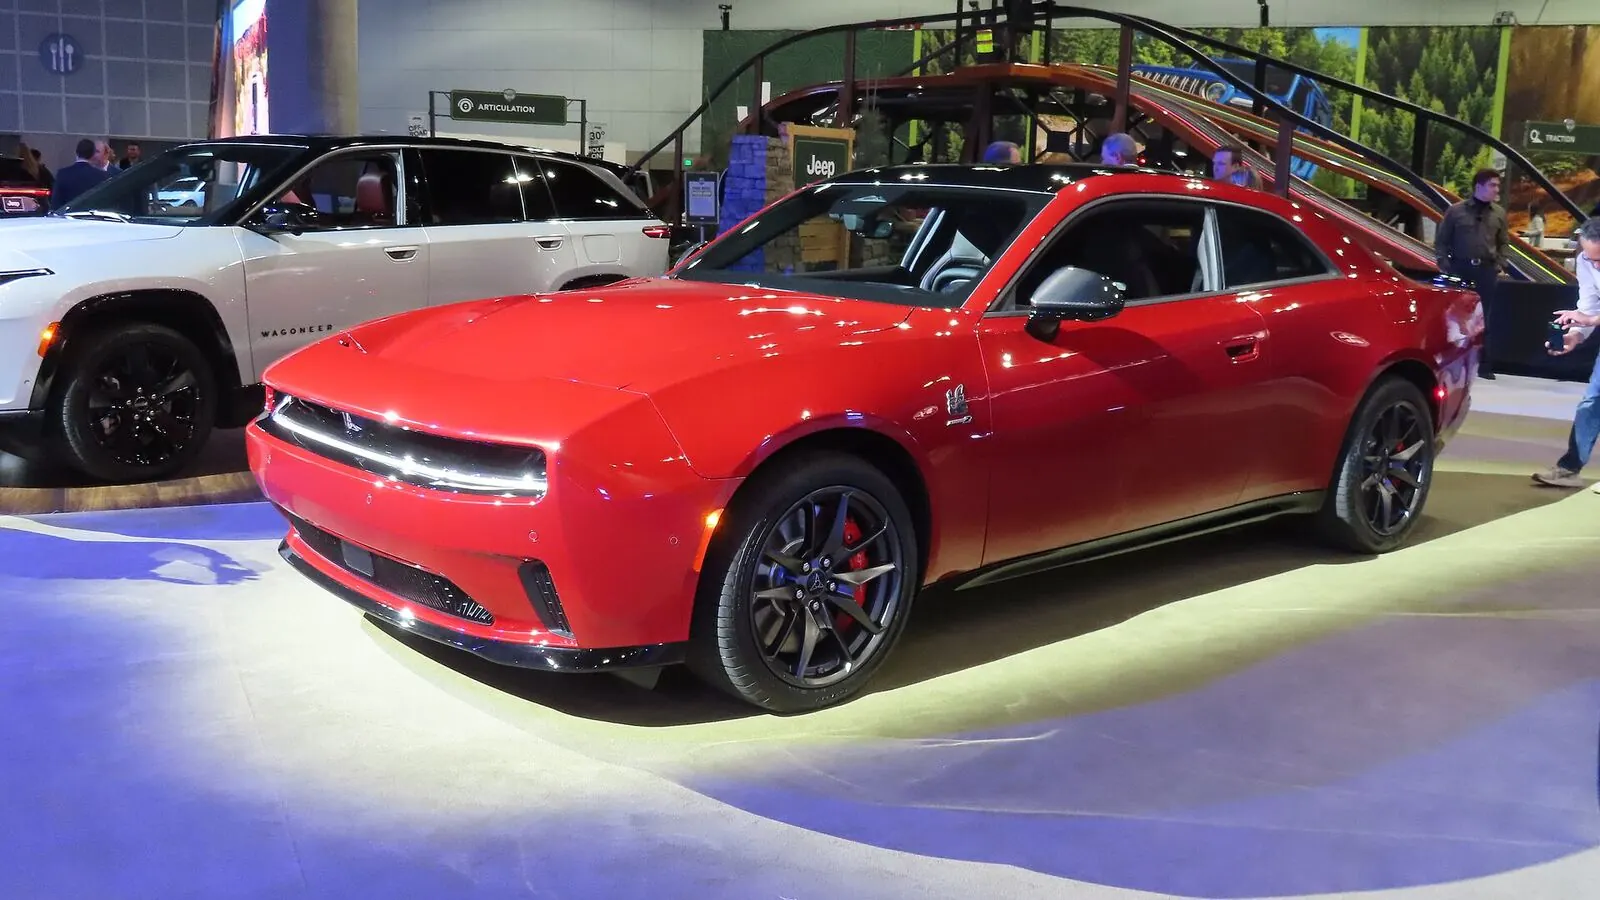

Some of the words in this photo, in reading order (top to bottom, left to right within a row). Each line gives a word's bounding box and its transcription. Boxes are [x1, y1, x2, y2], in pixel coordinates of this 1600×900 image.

[478, 103, 535, 113] ARTICULATION
[1545, 134, 1576, 143] TRACTION
[807, 154, 835, 178] Jeep
[7, 199, 20, 208] Jeep
[261, 324, 333, 338] WAGONEER
